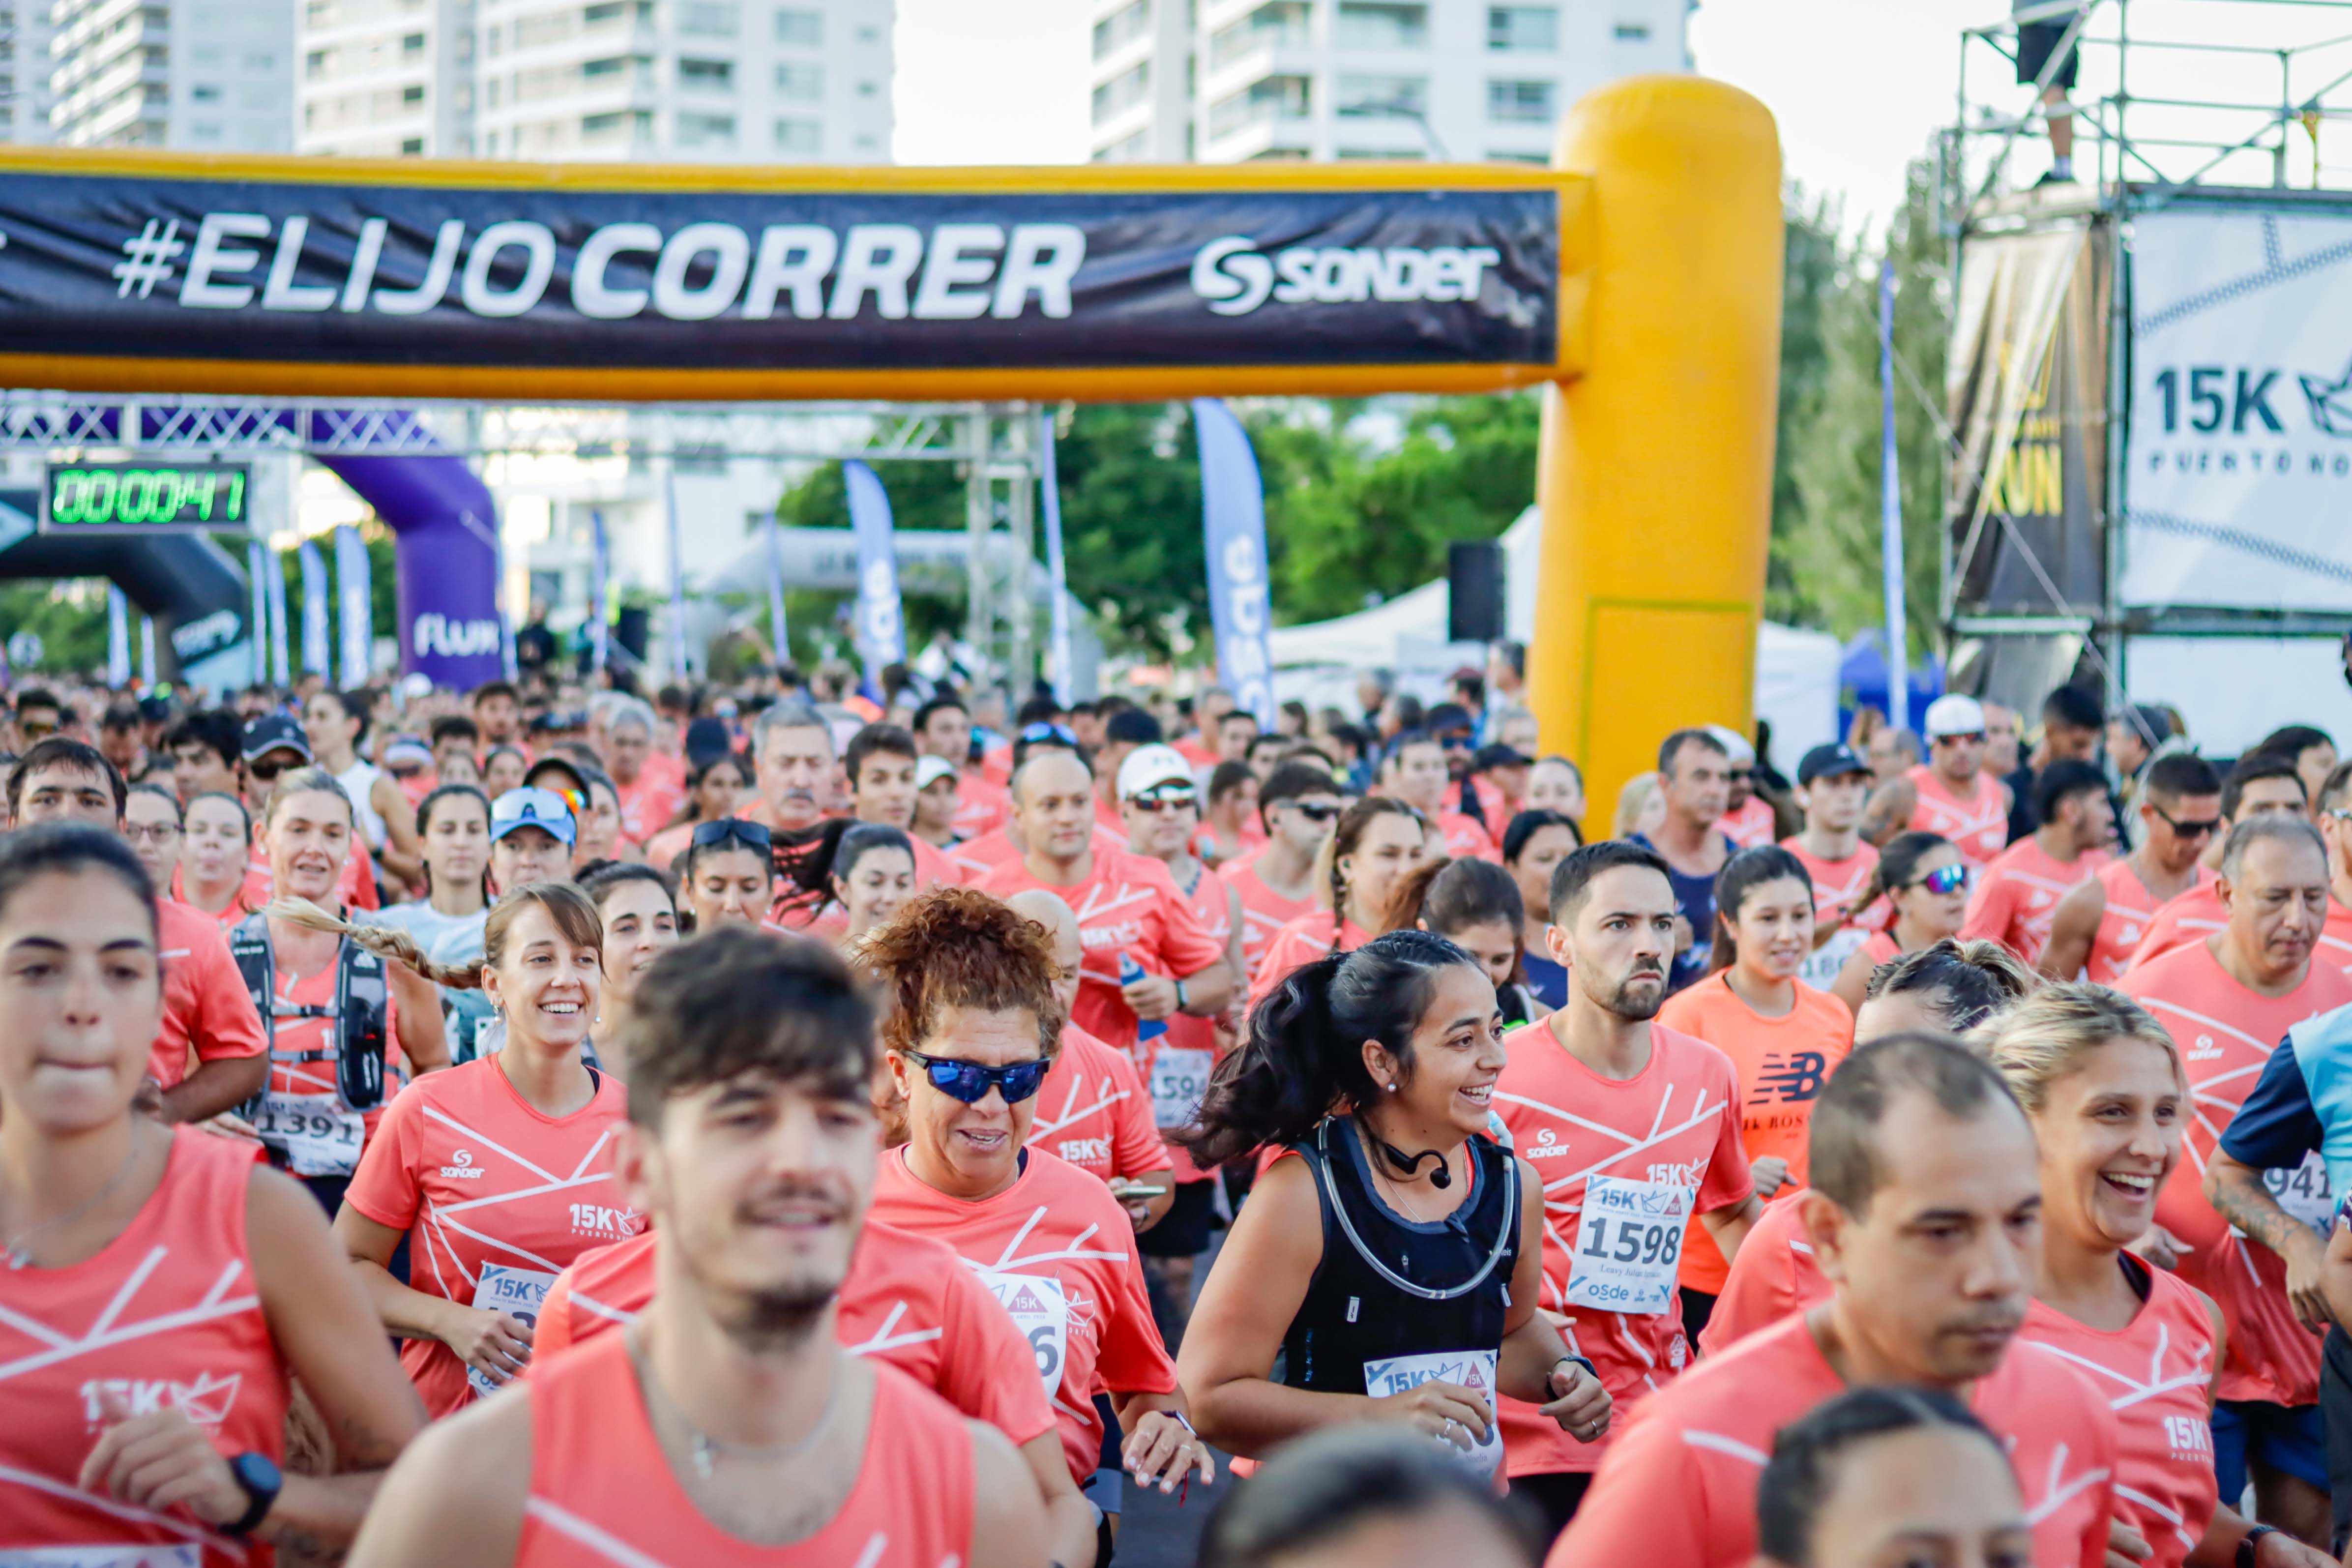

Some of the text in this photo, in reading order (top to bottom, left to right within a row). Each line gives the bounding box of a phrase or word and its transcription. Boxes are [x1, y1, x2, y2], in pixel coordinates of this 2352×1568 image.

[2156, 370, 2284, 433] 15K
[2148, 450, 2292, 473] PUERTO
[260, 1113, 356, 1146] 1391
[1059, 1139, 1097, 1161] 15K
[1646, 1163, 1683, 1186] 15K
[1601, 1188, 1637, 1210] 15K
[569, 1203, 614, 1231] 15K
[571, 1228, 614, 1239] PUERTO
[1583, 1217, 1681, 1265] 1598
[1600, 1264, 1623, 1276] Leavy
[495, 1277, 532, 1301] 15K
[1015, 1297, 1038, 1310] 15K
[1384, 1370, 1425, 1395] 15K
[1468, 1373, 1481, 1386] 15K
[2164, 1415, 2207, 1452] 15K
